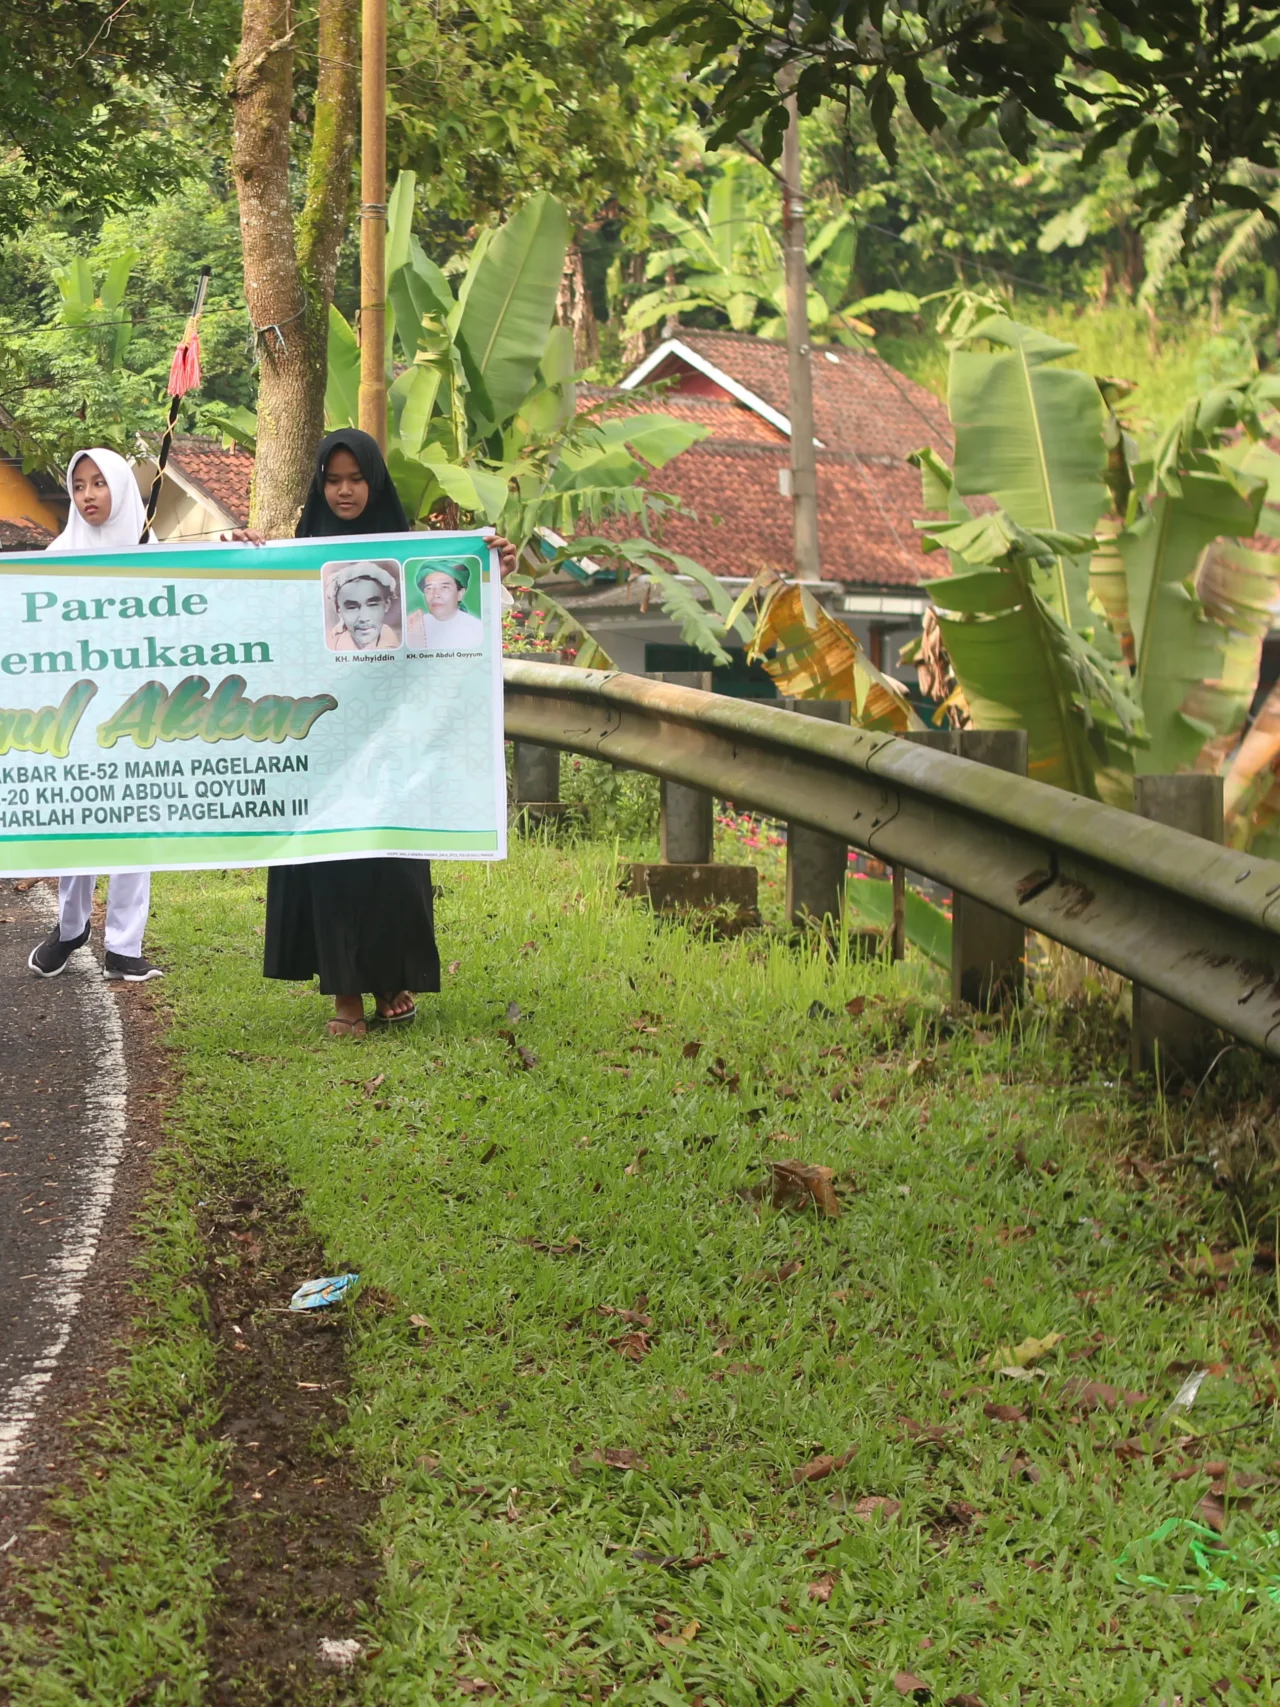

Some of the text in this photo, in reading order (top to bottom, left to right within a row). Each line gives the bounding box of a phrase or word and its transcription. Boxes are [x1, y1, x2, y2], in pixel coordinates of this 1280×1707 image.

[20, 585, 208, 624] Parade
[335, 654, 395, 663] KH. Muhyiddin
[96, 674, 338, 749] Akbar
[63, 762, 118, 783] KE-52
[125, 759, 184, 779] MAMA
[191, 755, 309, 776] PAGELARAN
[37, 784, 115, 805] KH.OOM
[122, 780, 188, 800] ABDUL
[194, 778, 266, 799] QOYUM
[81, 805, 161, 826] PONPES
[167, 801, 285, 822] PAGELARAN
[292, 799, 309, 816] III
